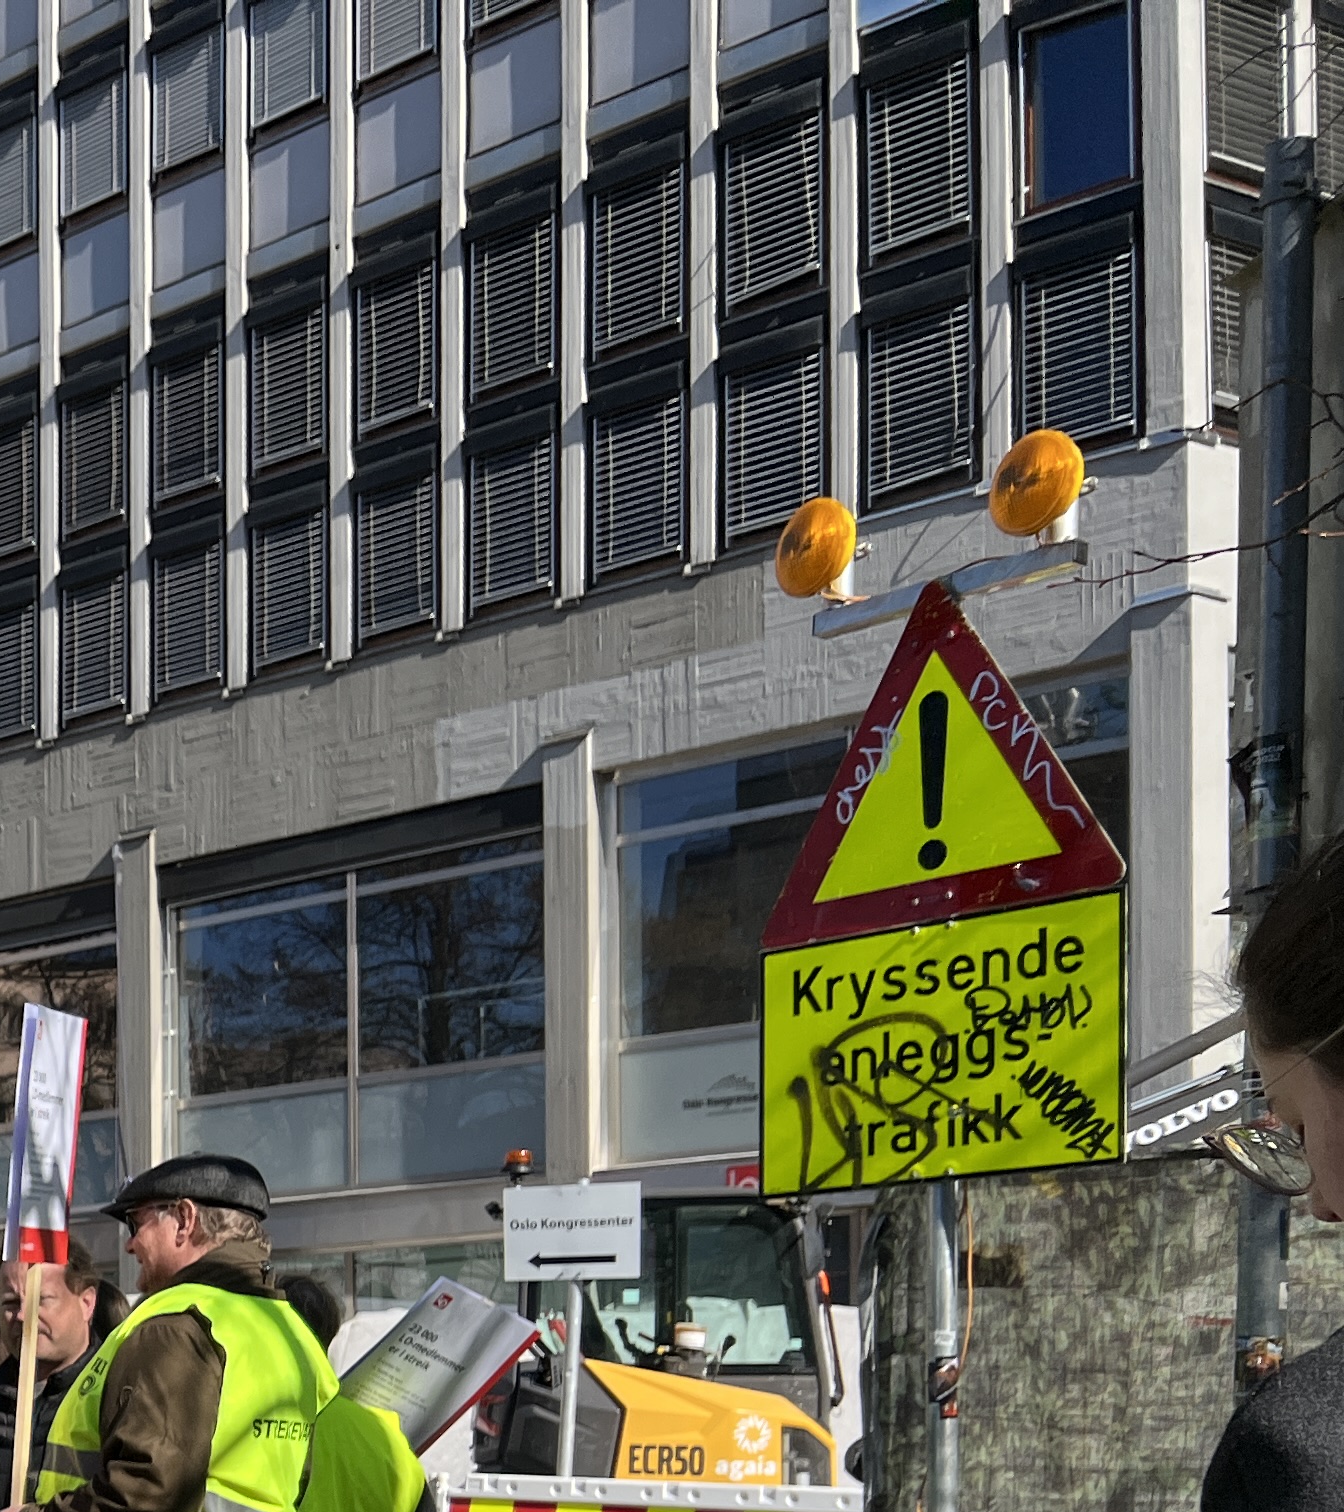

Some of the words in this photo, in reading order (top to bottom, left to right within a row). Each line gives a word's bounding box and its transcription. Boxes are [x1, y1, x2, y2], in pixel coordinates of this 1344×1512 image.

[792, 927, 1085, 1020] Kryssende
[820, 1025, 1052, 1086] anleggs-
[844, 1093, 1023, 1157] trafikk
[509, 1218, 538, 1231] Oslo
[540, 1215, 635, 1233] Kongressenter
[628, 1445, 706, 1476] ECR50
[715, 1456, 778, 1482] agaia
